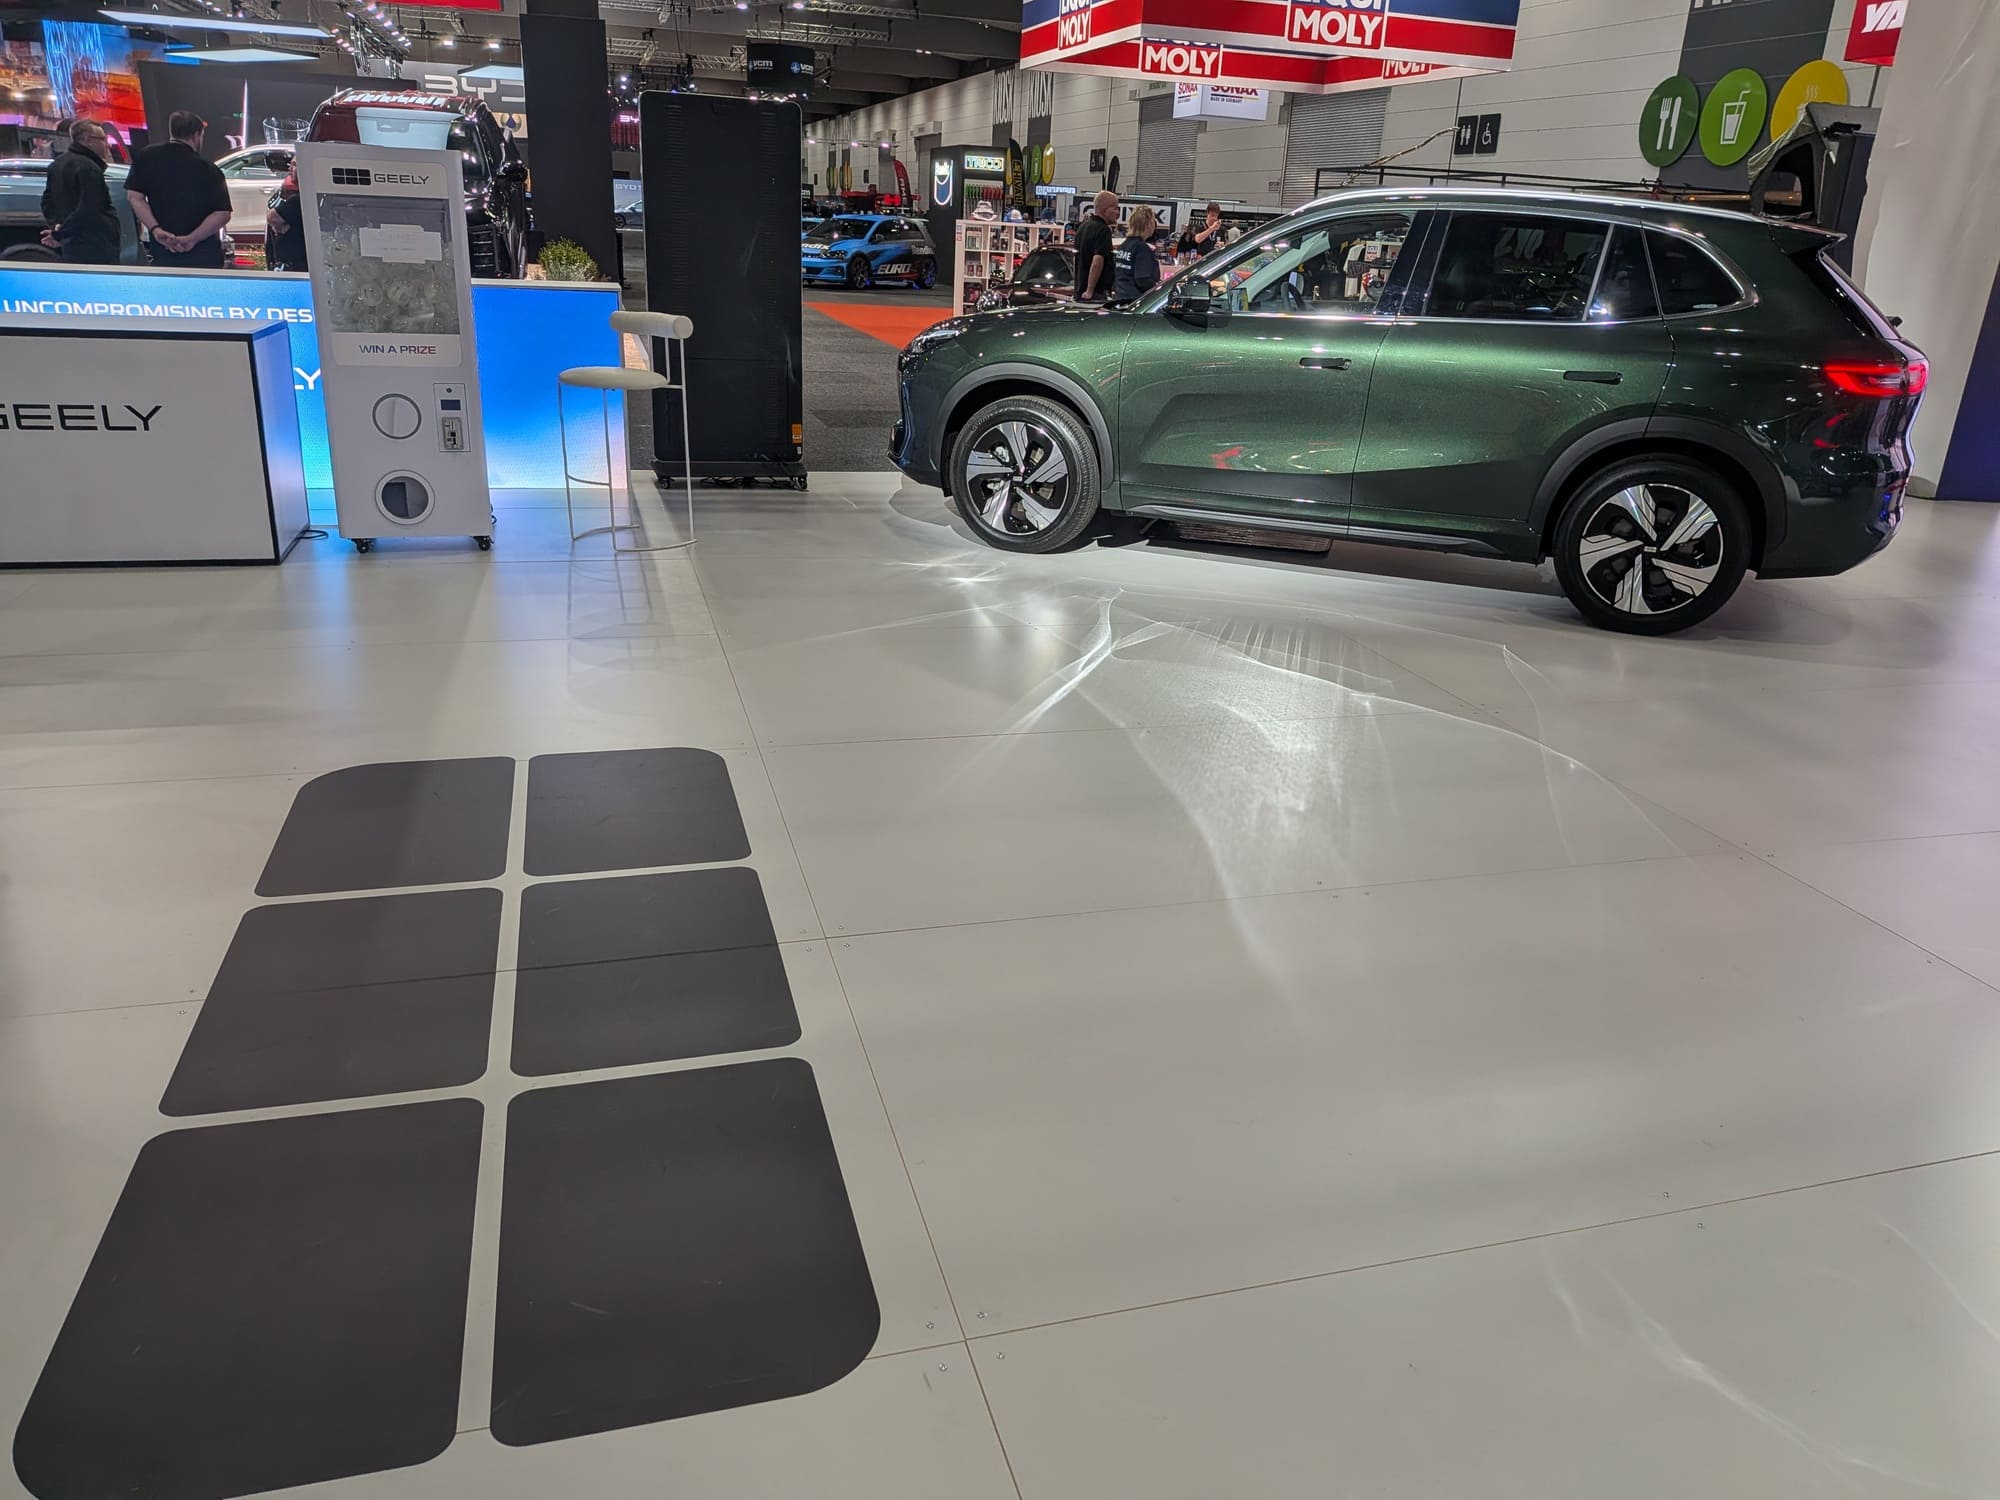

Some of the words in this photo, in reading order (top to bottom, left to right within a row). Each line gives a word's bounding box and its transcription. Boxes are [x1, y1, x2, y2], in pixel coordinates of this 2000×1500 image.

[1060, 11, 1090, 47] MOLY
[1292, 9, 1382, 46] MOLY
[1145, 46, 1218, 75] MOLY
[993, 67, 1014, 124] KIOSK
[1028, 71, 1052, 118] KIOSK
[1178, 82, 1198, 94] SONAX
[374, 173, 429, 184] GEELY
[878, 263, 912, 274] EURO
[3, 299, 222, 319] UNCOMPROMISING
[229, 306, 261, 320] BY
[267, 308, 313, 322] DES
[359, 345, 385, 354] WIN
[388, 346, 398, 354] A
[400, 346, 437, 355] PRIZE
[0, 403, 163, 431] EELY
